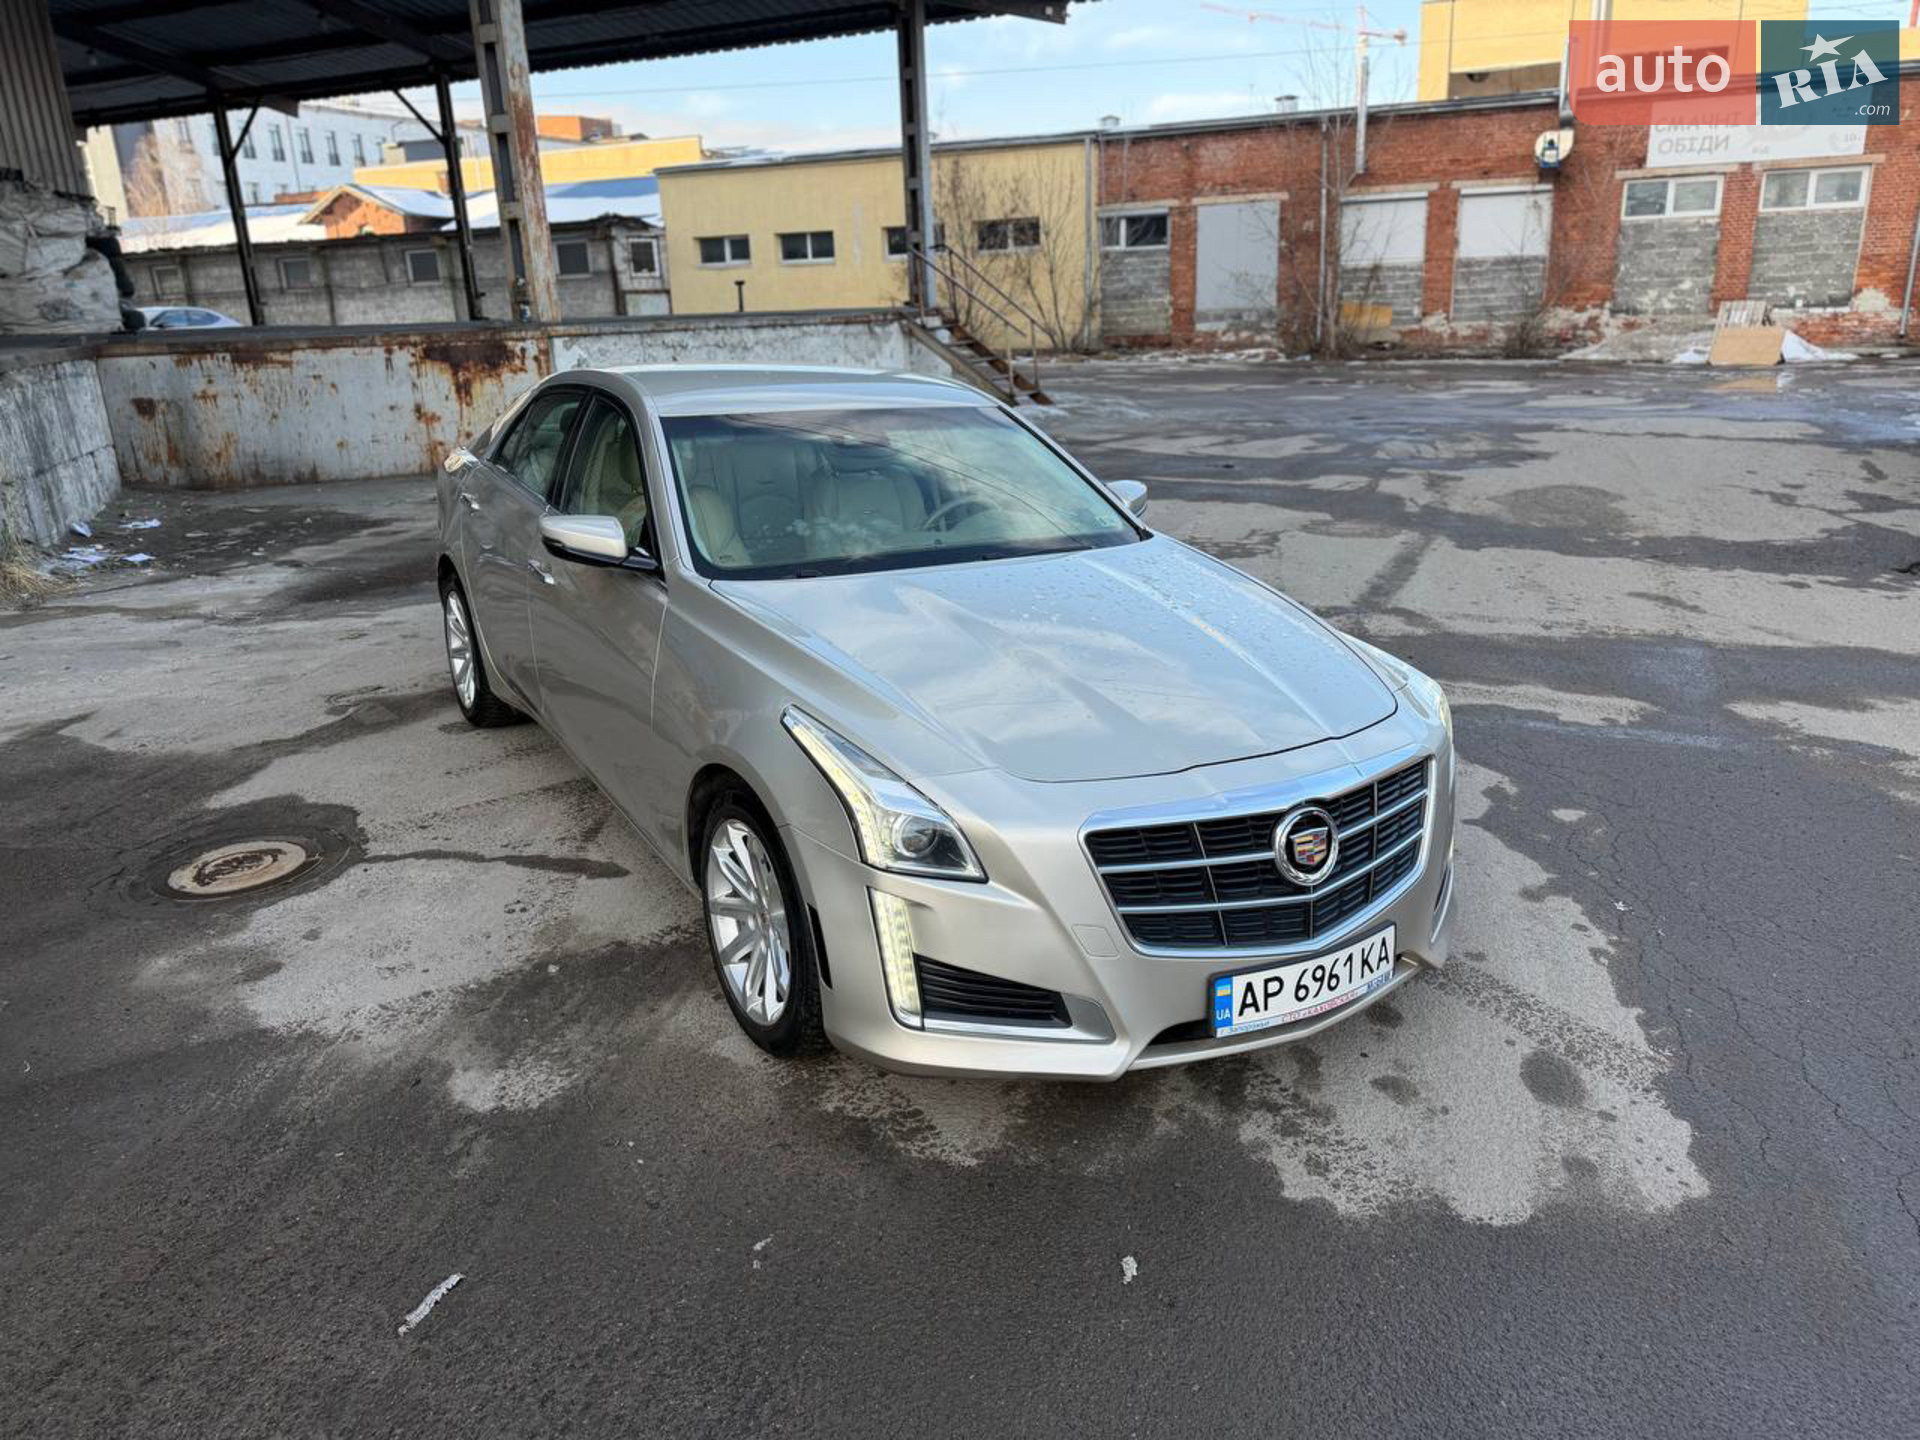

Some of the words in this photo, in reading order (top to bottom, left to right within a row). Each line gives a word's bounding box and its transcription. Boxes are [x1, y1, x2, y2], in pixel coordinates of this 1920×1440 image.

[1657, 135, 1730, 156] ОБІДИ
[1238, 975, 1285, 1017] AP
[1294, 952, 1354, 1002] 6961
[1216, 1008, 1231, 1021] UA
